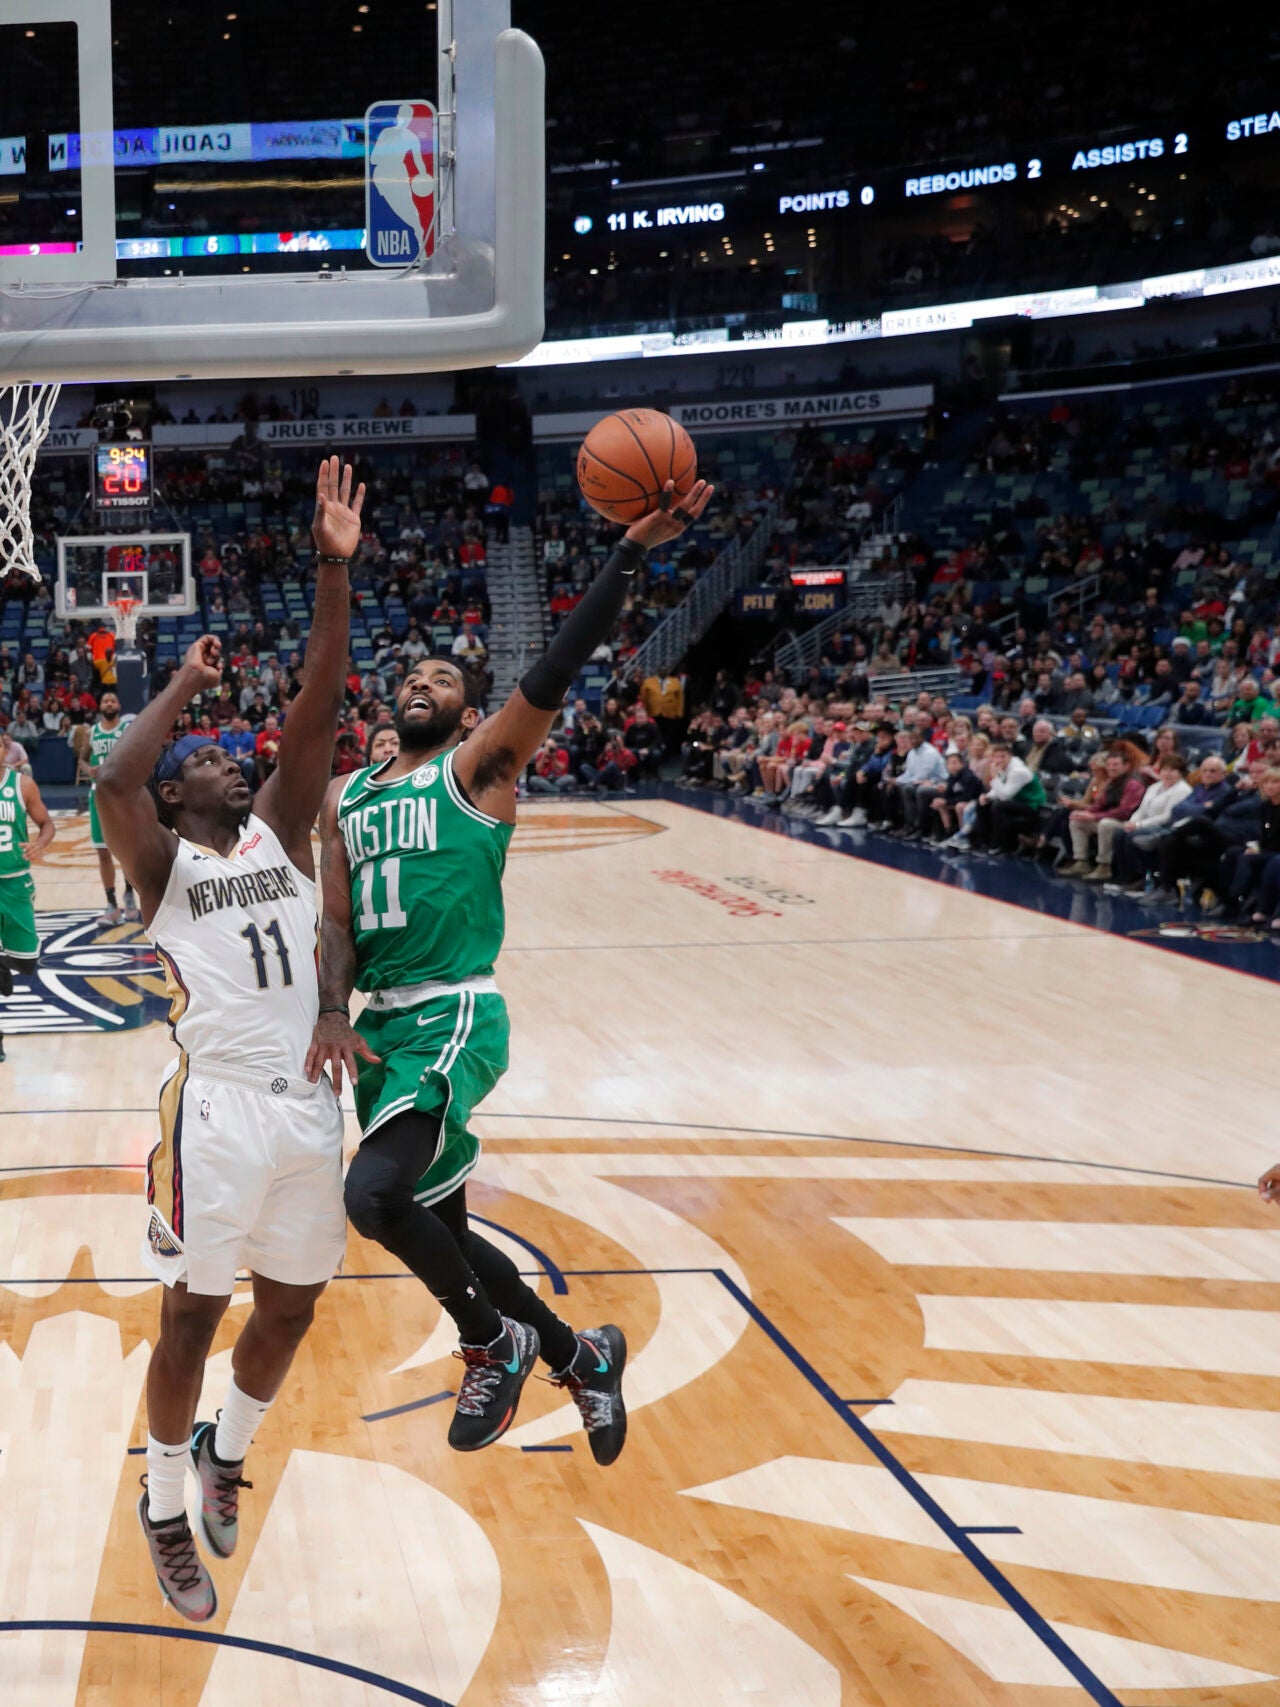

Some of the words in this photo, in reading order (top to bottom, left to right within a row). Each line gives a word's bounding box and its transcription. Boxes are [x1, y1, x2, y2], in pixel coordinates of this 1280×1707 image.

[1072, 138, 1165, 171] ASSISTS
[1174, 133, 1188, 155] 2
[905, 163, 1018, 197] REBOUNDS
[1027, 159, 1042, 179] 2
[779, 190, 850, 214] POINTS
[861, 186, 875, 205] 0
[607, 213, 627, 231] 11
[633, 210, 653, 229] K.
[657, 203, 725, 226] IRVING
[377, 230, 411, 256] NBA
[681, 402, 777, 423] MOORE'S
[783, 393, 882, 416] MANIACS
[267, 422, 336, 439] JRUE'S
[342, 419, 414, 436] KREWE
[109, 447, 145, 465] 9:24
[104, 464, 142, 493] 20
[112, 496, 150, 506] TISSOT
[186, 877, 233, 922] NEW
[360, 857, 407, 931] 11
[240, 918, 293, 990] 11
